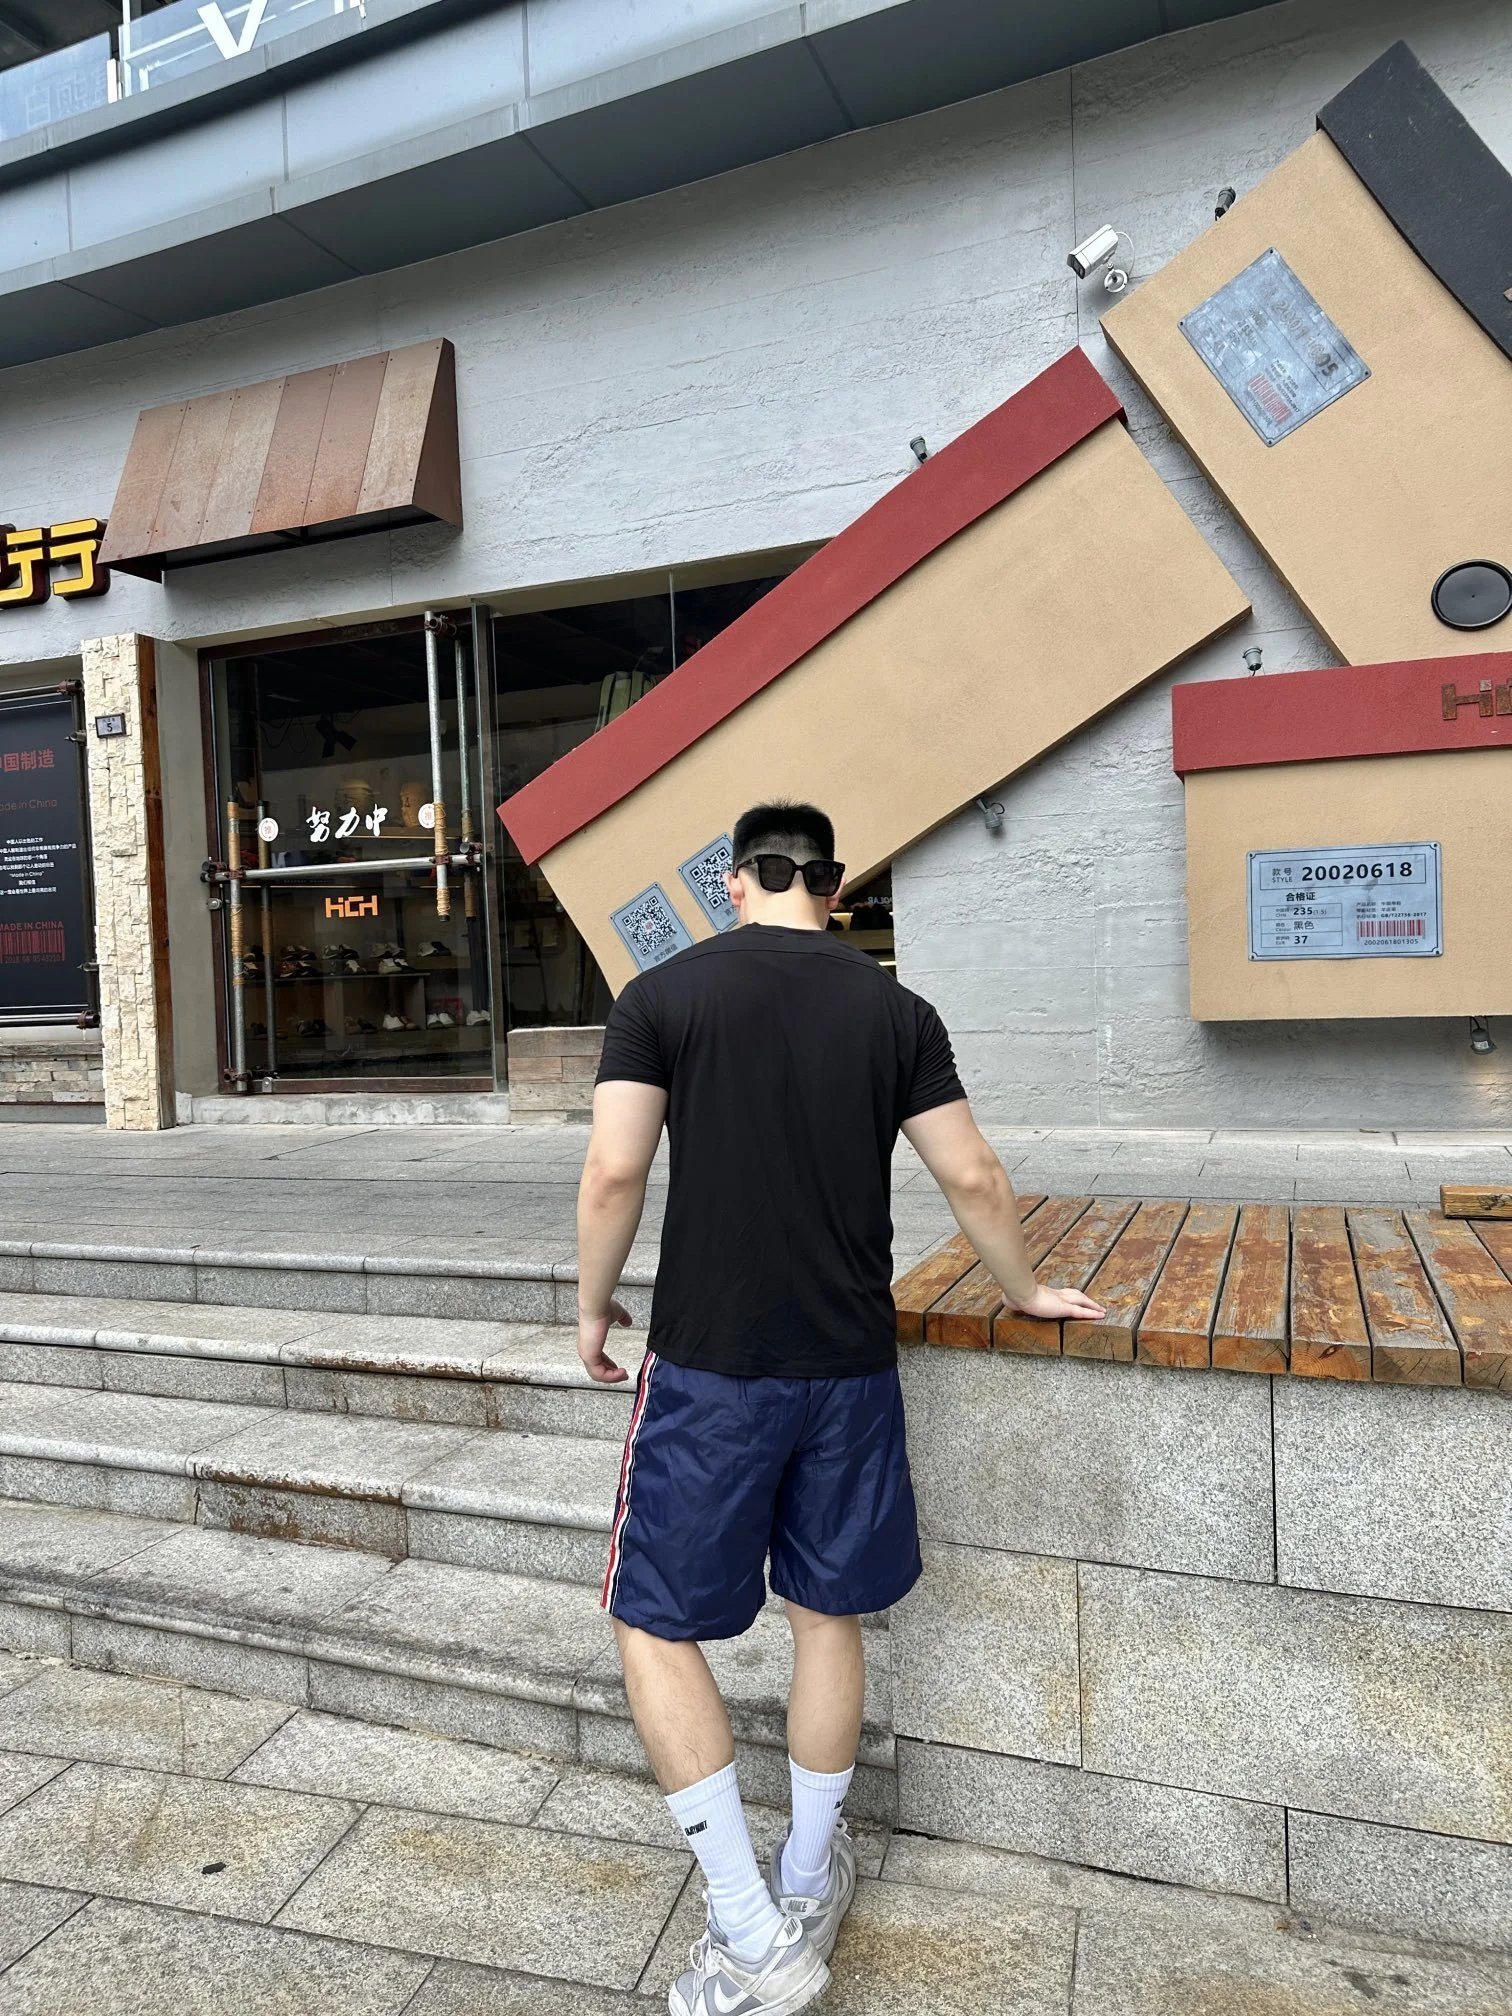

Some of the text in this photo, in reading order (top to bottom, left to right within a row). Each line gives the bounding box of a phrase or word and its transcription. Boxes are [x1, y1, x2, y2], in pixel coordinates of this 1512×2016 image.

[107, 722, 113, 733] 5
[0, 748, 55, 773] 国制造
[29, 799, 58, 809] China
[306, 803, 389, 843] 努力中
[1272, 861, 1413, 882] 款号 20020618
[1285, 891, 1316, 902] 合格证
[1293, 907, 1313, 916] 235
[35, 920, 65, 930] CHINA
[1293, 920, 1315, 930] 黑色
[1294, 935, 1308, 944] 37
[787, 1899, 809, 1913] NIKE
